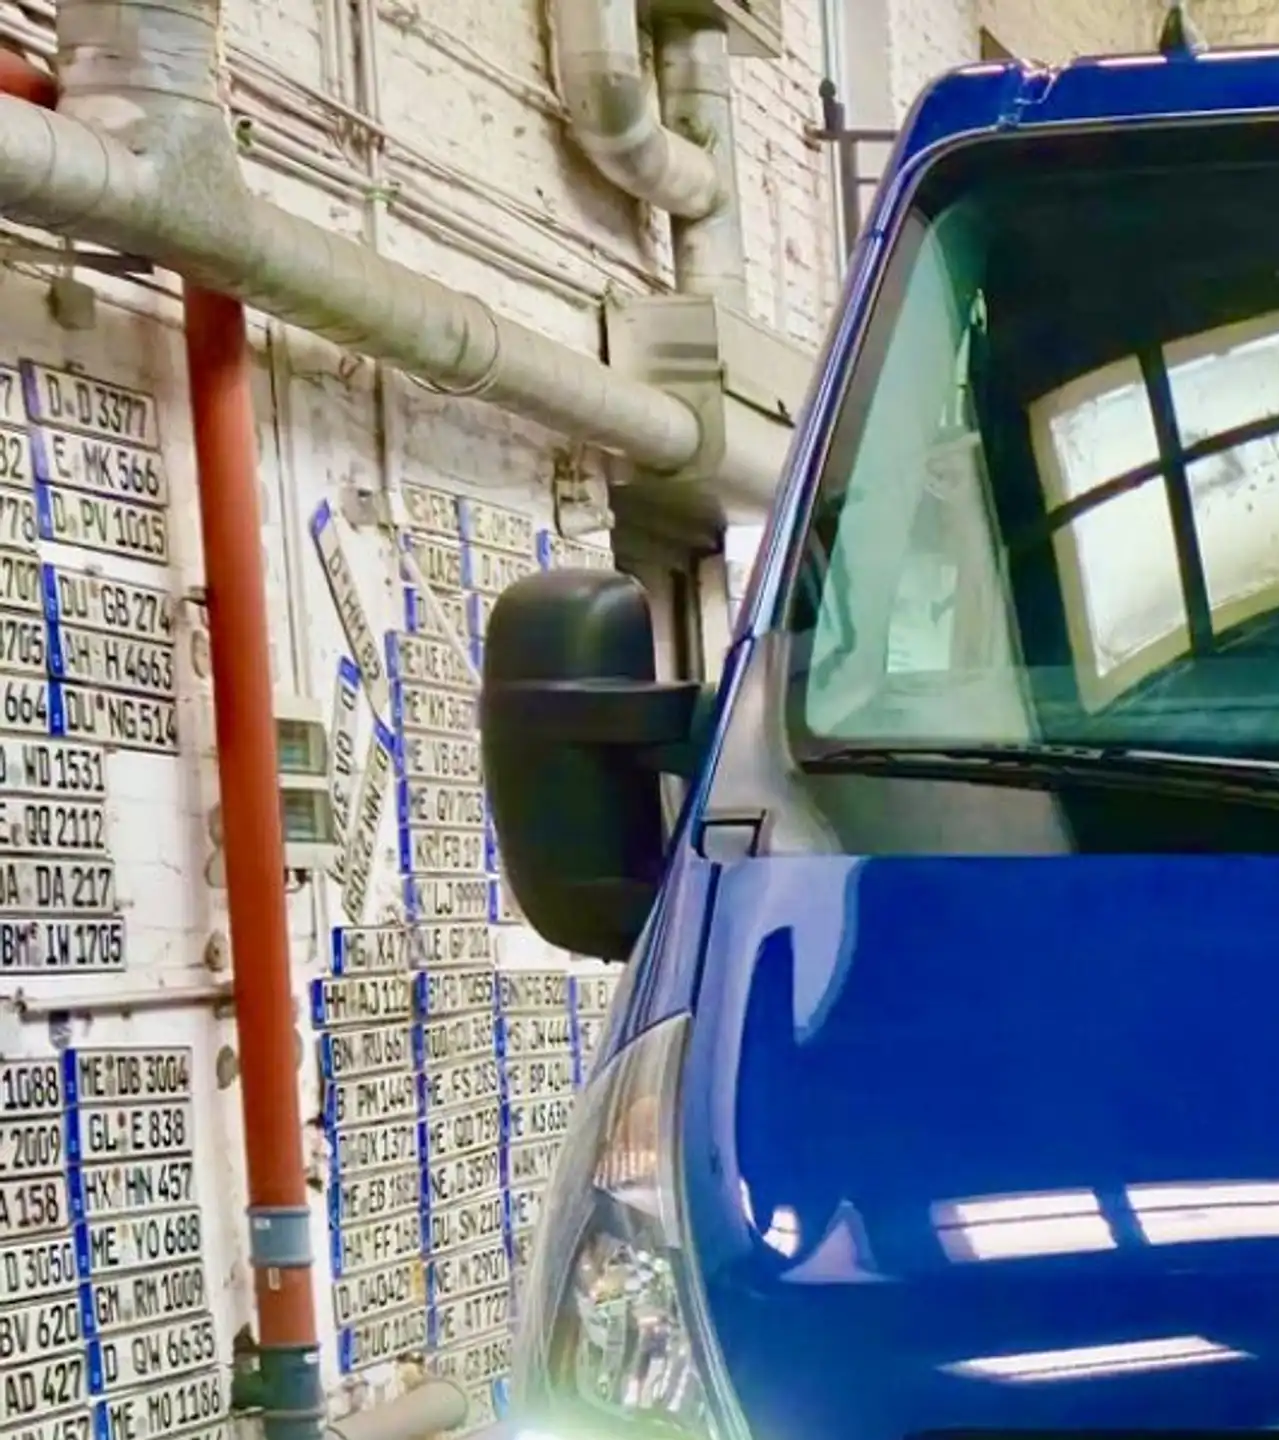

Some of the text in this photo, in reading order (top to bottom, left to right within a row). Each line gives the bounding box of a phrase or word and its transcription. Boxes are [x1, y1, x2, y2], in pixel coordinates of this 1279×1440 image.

[96, 387, 148, 438] 3377
[117, 451, 159, 497] 566
[82, 498, 165, 555] PV 1015
[134, 592, 170, 635] 274
[121, 644, 173, 692] 4663
[5, 682, 48, 724] 664
[143, 703, 178, 746] 514
[55, 750, 104, 791] 1531
[56, 806, 104, 849] 2112
[36, 865, 111, 907] DA 217
[76, 924, 122, 965] 1705
[3, 1066, 59, 1111] 1088
[145, 1055, 189, 1093] 3004
[11, 1126, 60, 1169] 2009
[89, 1109, 185, 1152] GL 838
[158, 1162, 193, 1203] 457
[15, 1182, 58, 1228] 158
[164, 1214, 201, 1256] 688
[25, 1243, 75, 1290] 3050
[37, 1303, 79, 1349] 620
[167, 1321, 215, 1369] 6635
[4, 1360, 82, 1418] AD 427
